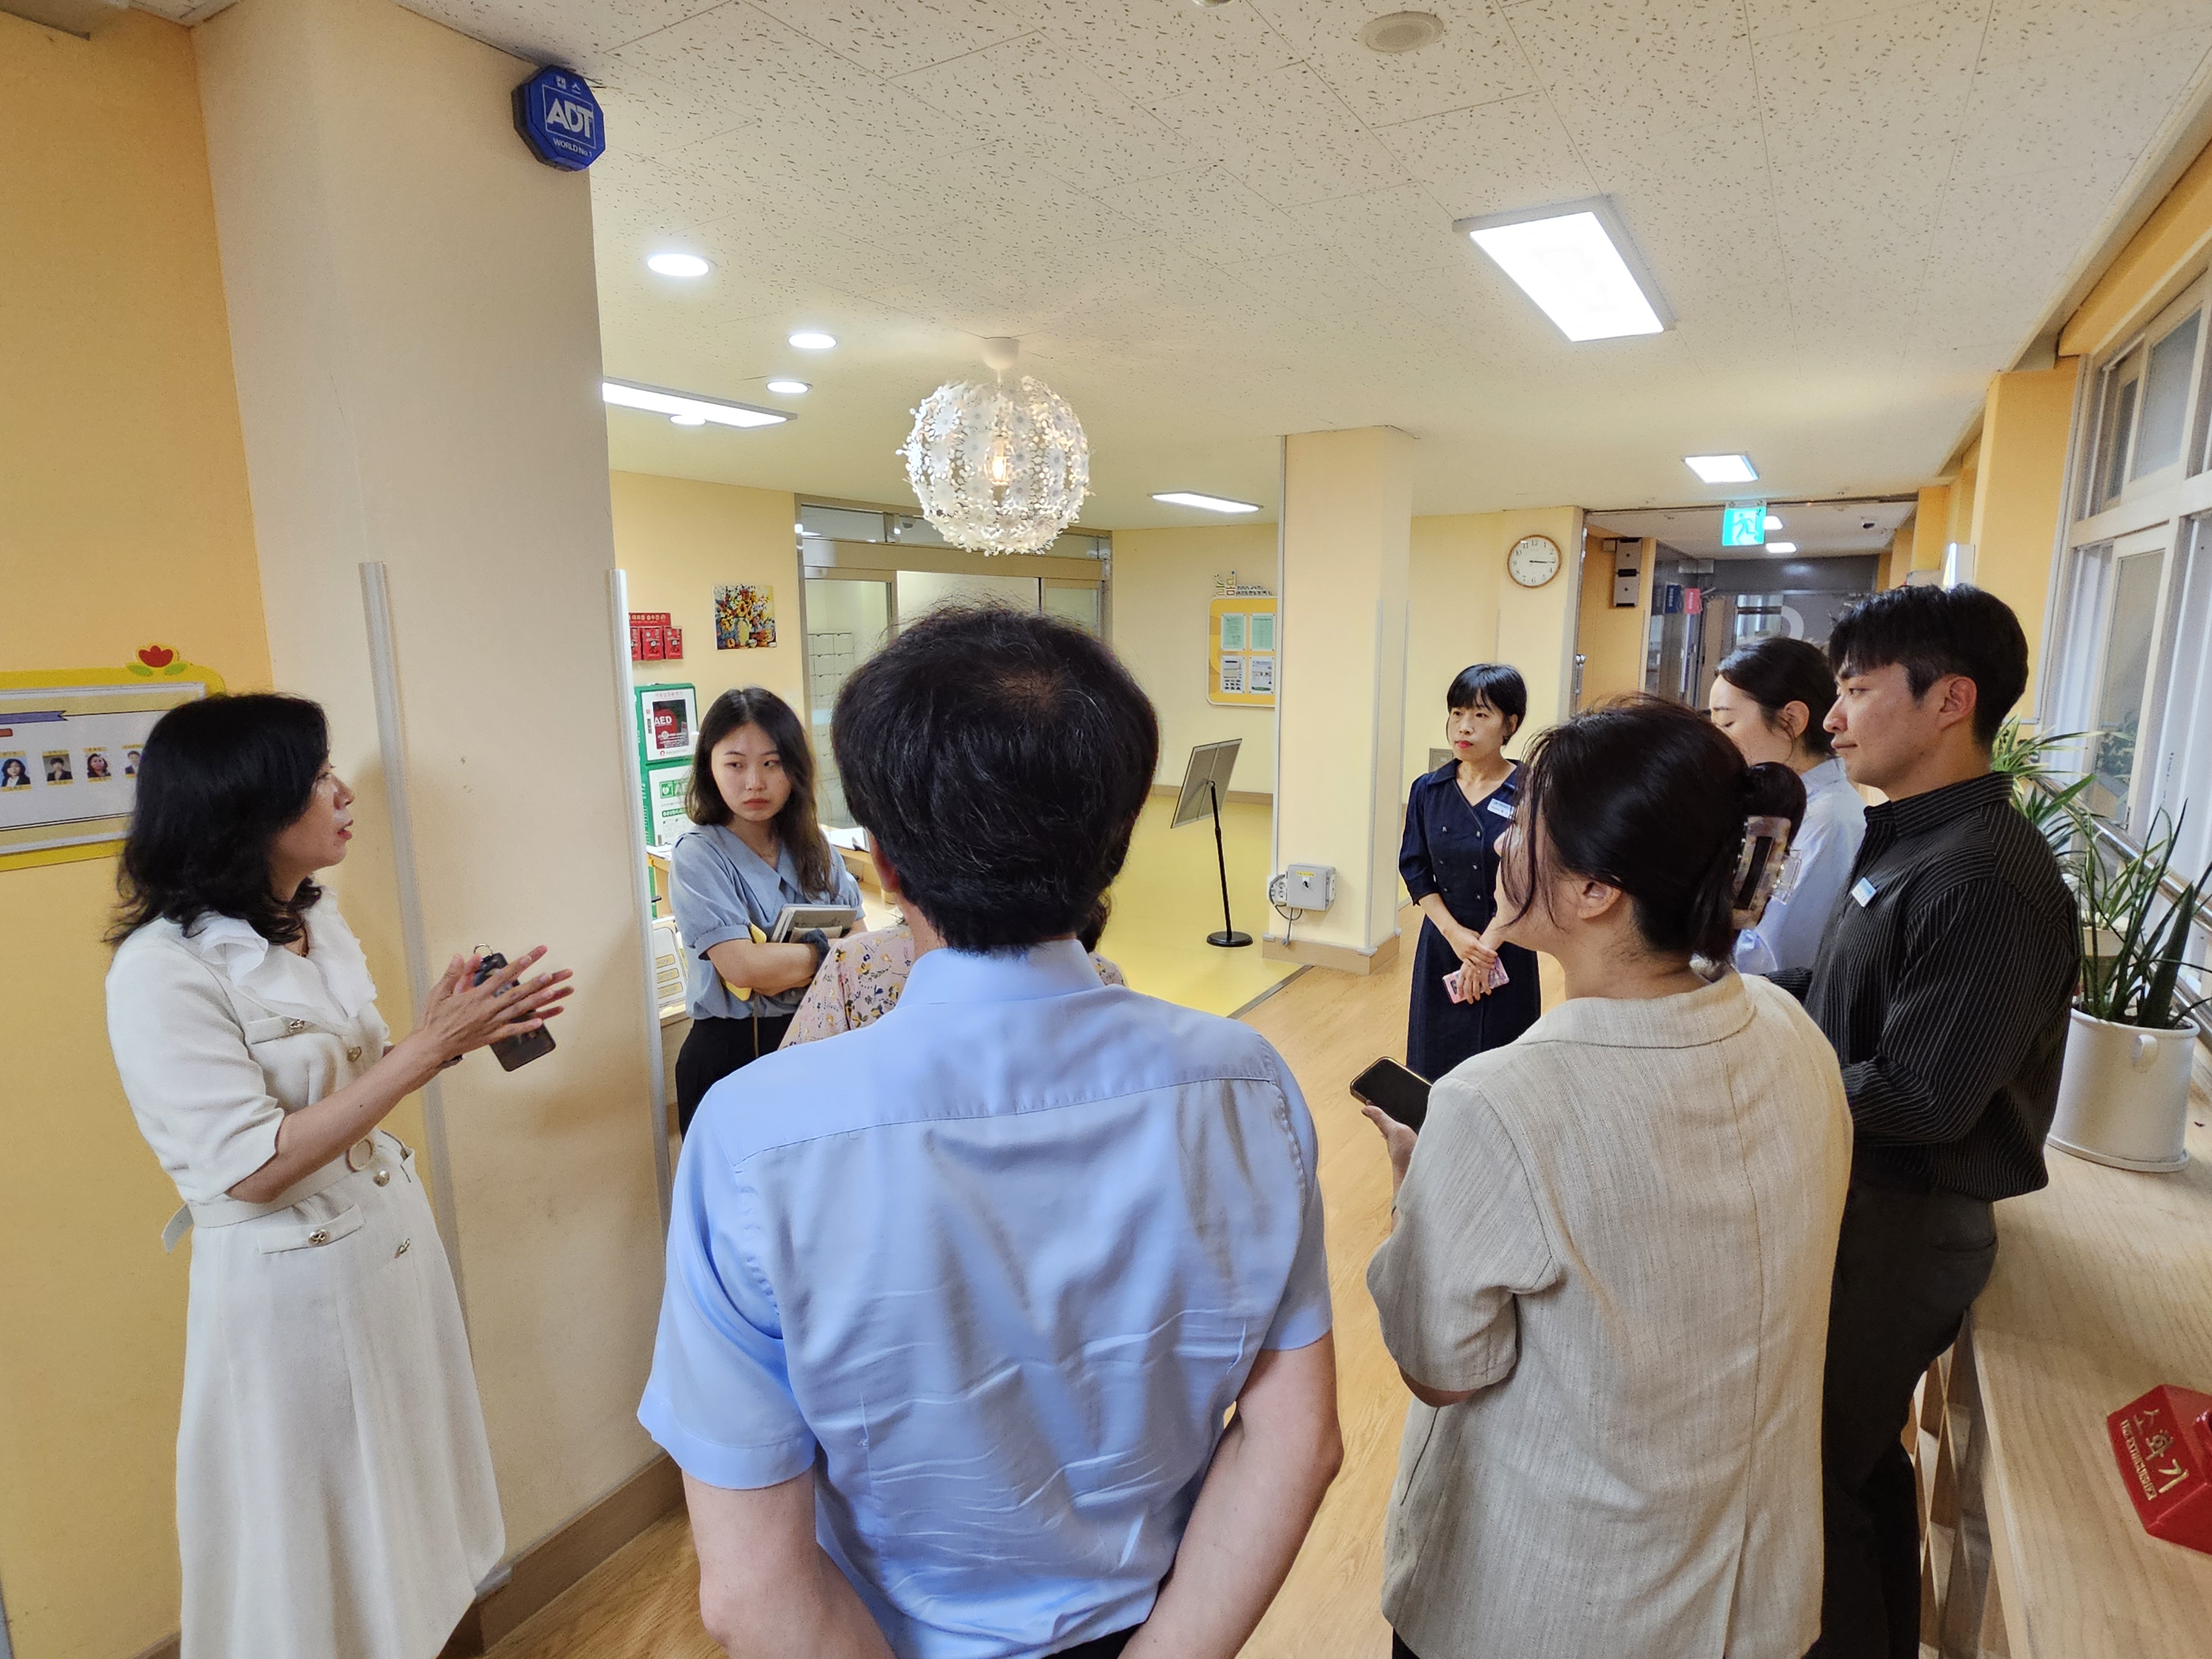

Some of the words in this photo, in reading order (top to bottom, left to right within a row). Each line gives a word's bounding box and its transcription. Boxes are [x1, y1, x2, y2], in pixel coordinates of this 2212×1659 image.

[555, 75, 581, 95] 캡스
[546, 97, 593, 138] ADT
[553, 137, 578, 153] WORLD
[578, 148, 592, 157] No.1
[654, 716, 672, 725] AED
[2133, 1408, 2189, 1493] 소화기
[2126, 1436, 2157, 1501] EXTINGUISHER
